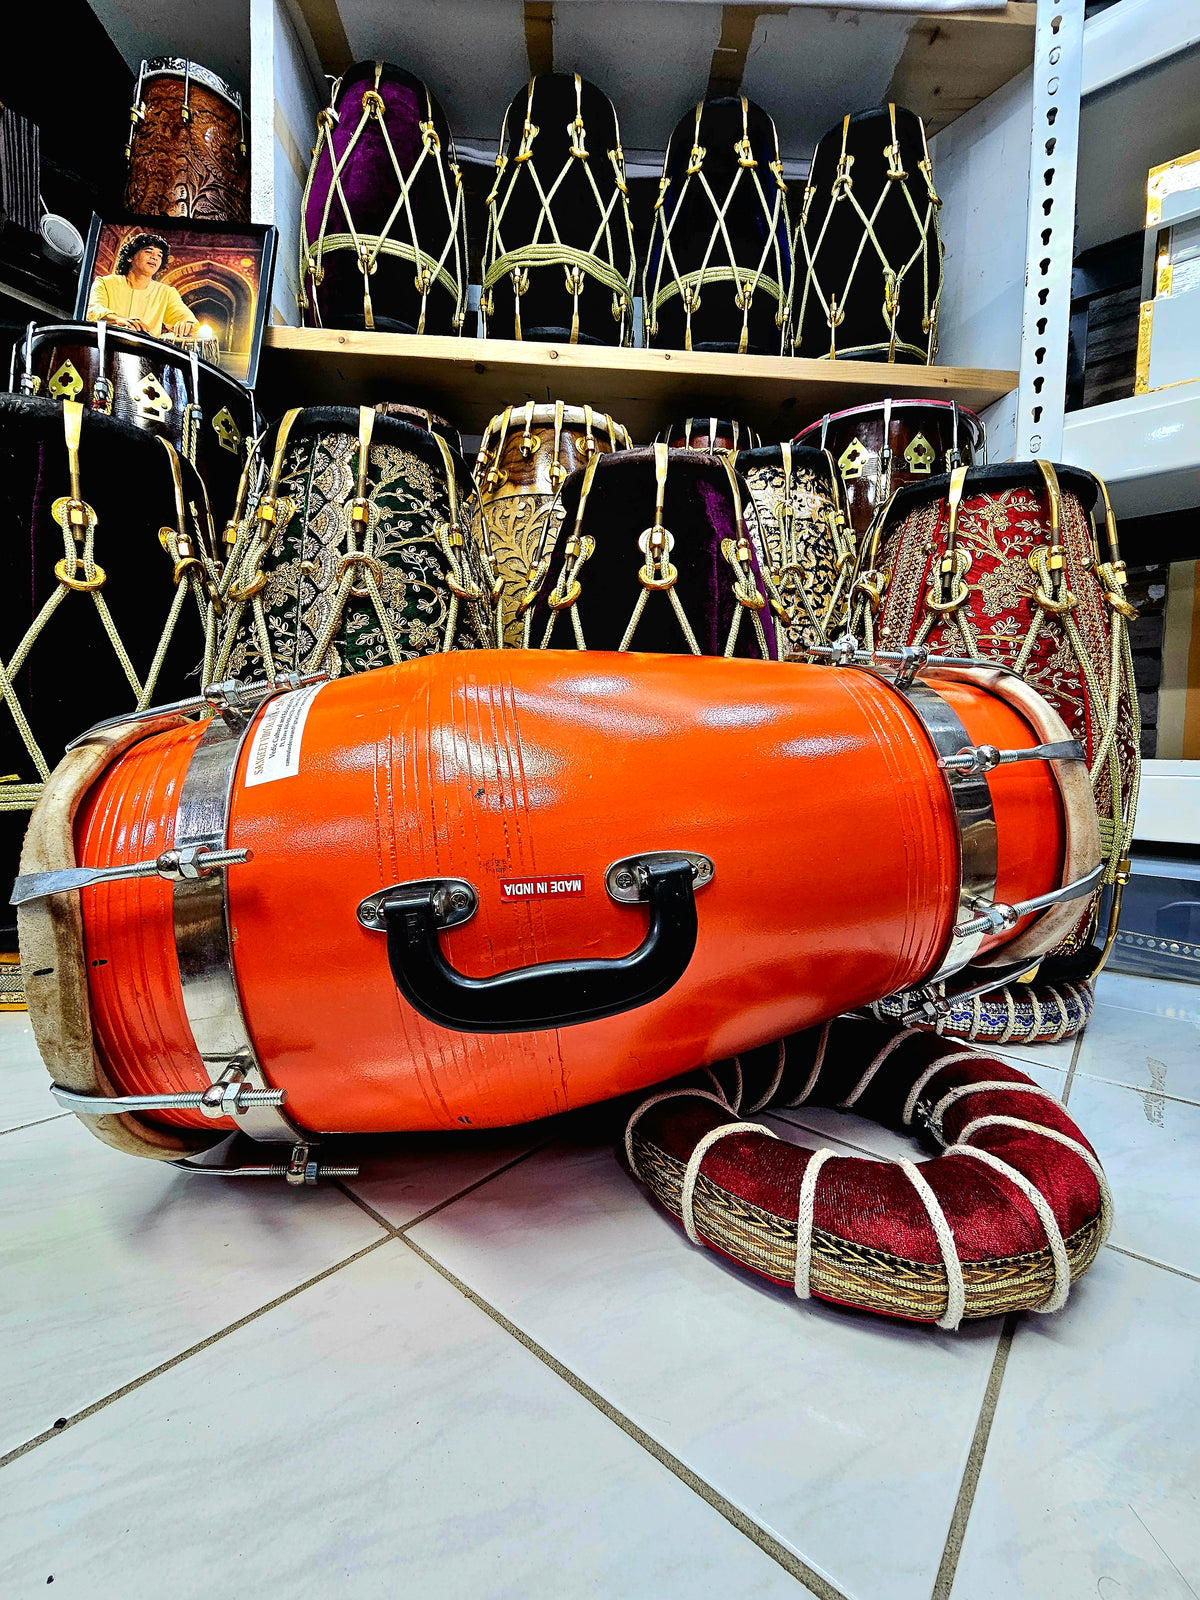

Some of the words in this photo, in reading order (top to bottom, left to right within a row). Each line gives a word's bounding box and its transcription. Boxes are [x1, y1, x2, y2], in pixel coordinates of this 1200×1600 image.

[272, 723, 283, 744] Cultural
[269, 742, 278, 759] Vedic
[254, 743, 269, 775] SANGEET
[503, 883, 535, 896] INDIA
[537, 882, 548, 894] IN
[550, 879, 582, 893] MADE
